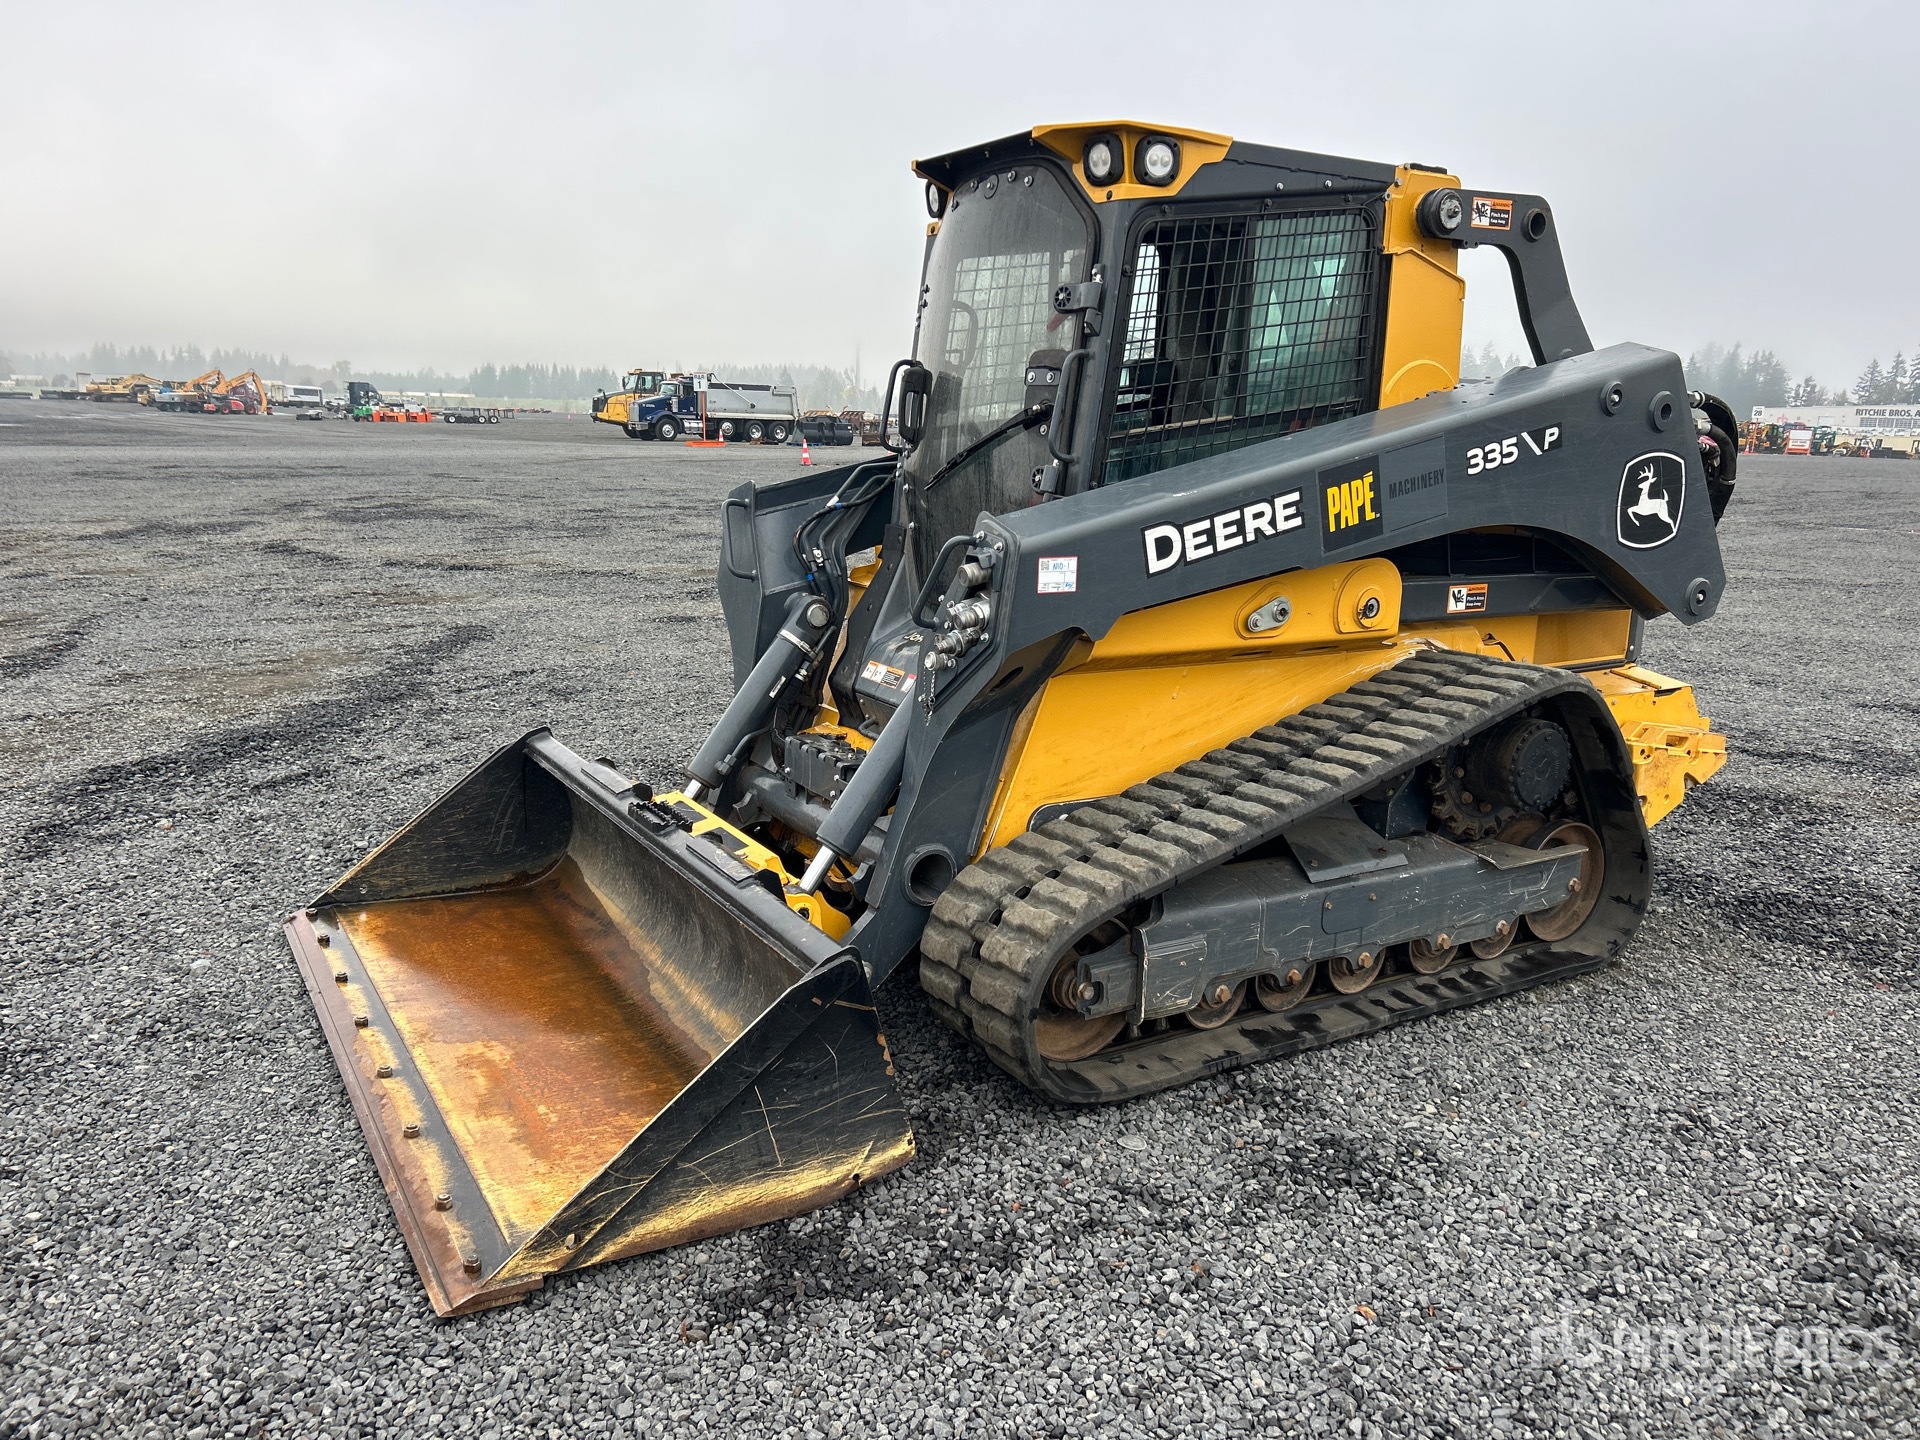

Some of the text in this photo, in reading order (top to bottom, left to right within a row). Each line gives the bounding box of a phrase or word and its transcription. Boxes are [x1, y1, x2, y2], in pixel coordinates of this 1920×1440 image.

[1855, 408, 1887, 416] RITCHIE
[1889, 409, 1913, 417] BROS.
[1388, 468, 1445, 499] MACHINERY
[1144, 491, 1303, 574] DEERE
